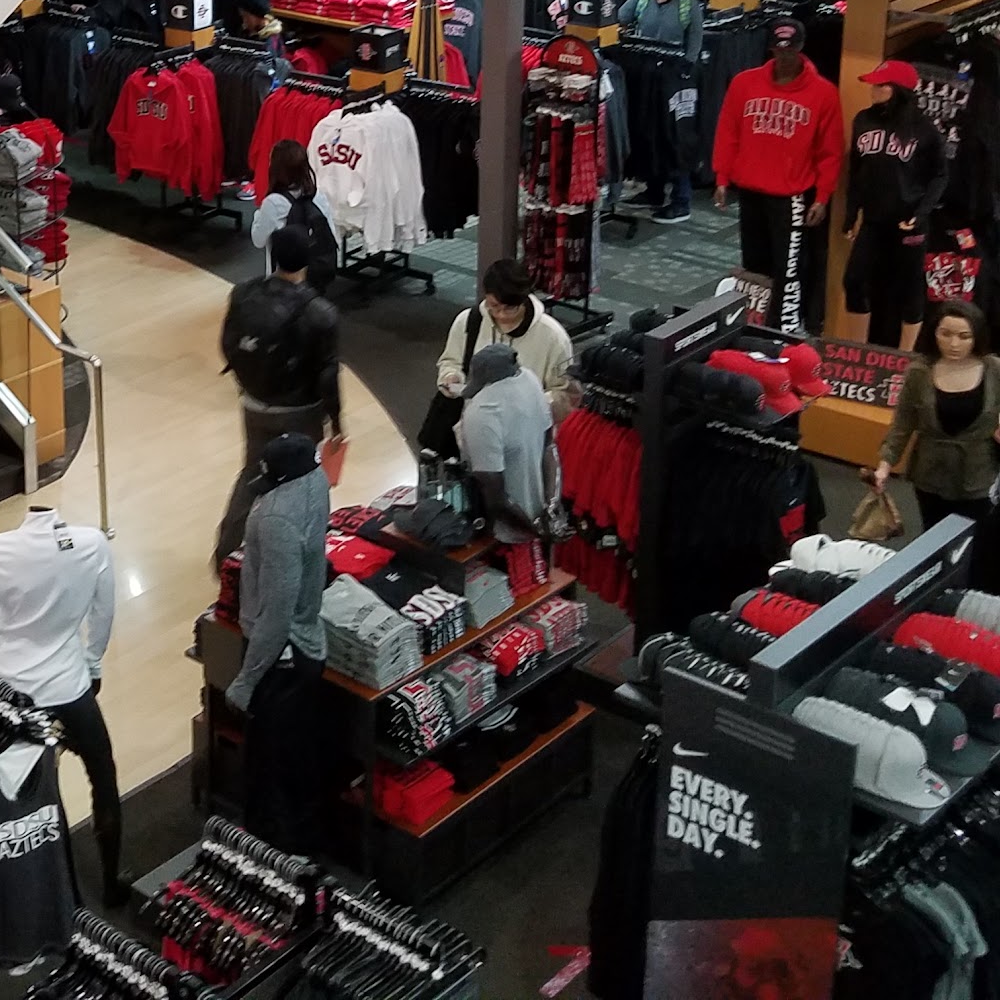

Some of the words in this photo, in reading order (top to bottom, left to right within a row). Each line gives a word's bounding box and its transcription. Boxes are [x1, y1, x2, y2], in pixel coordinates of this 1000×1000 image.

[821, 362, 876, 385] STATE
[824, 343, 862, 363] SAN
[865, 350, 911, 372] DIEG
[822, 378, 876, 402] ZTECS
[670, 765, 754, 820] EVERY.
[667, 813, 725, 859] DAY.
[668, 790, 762, 849] SINGLE.
